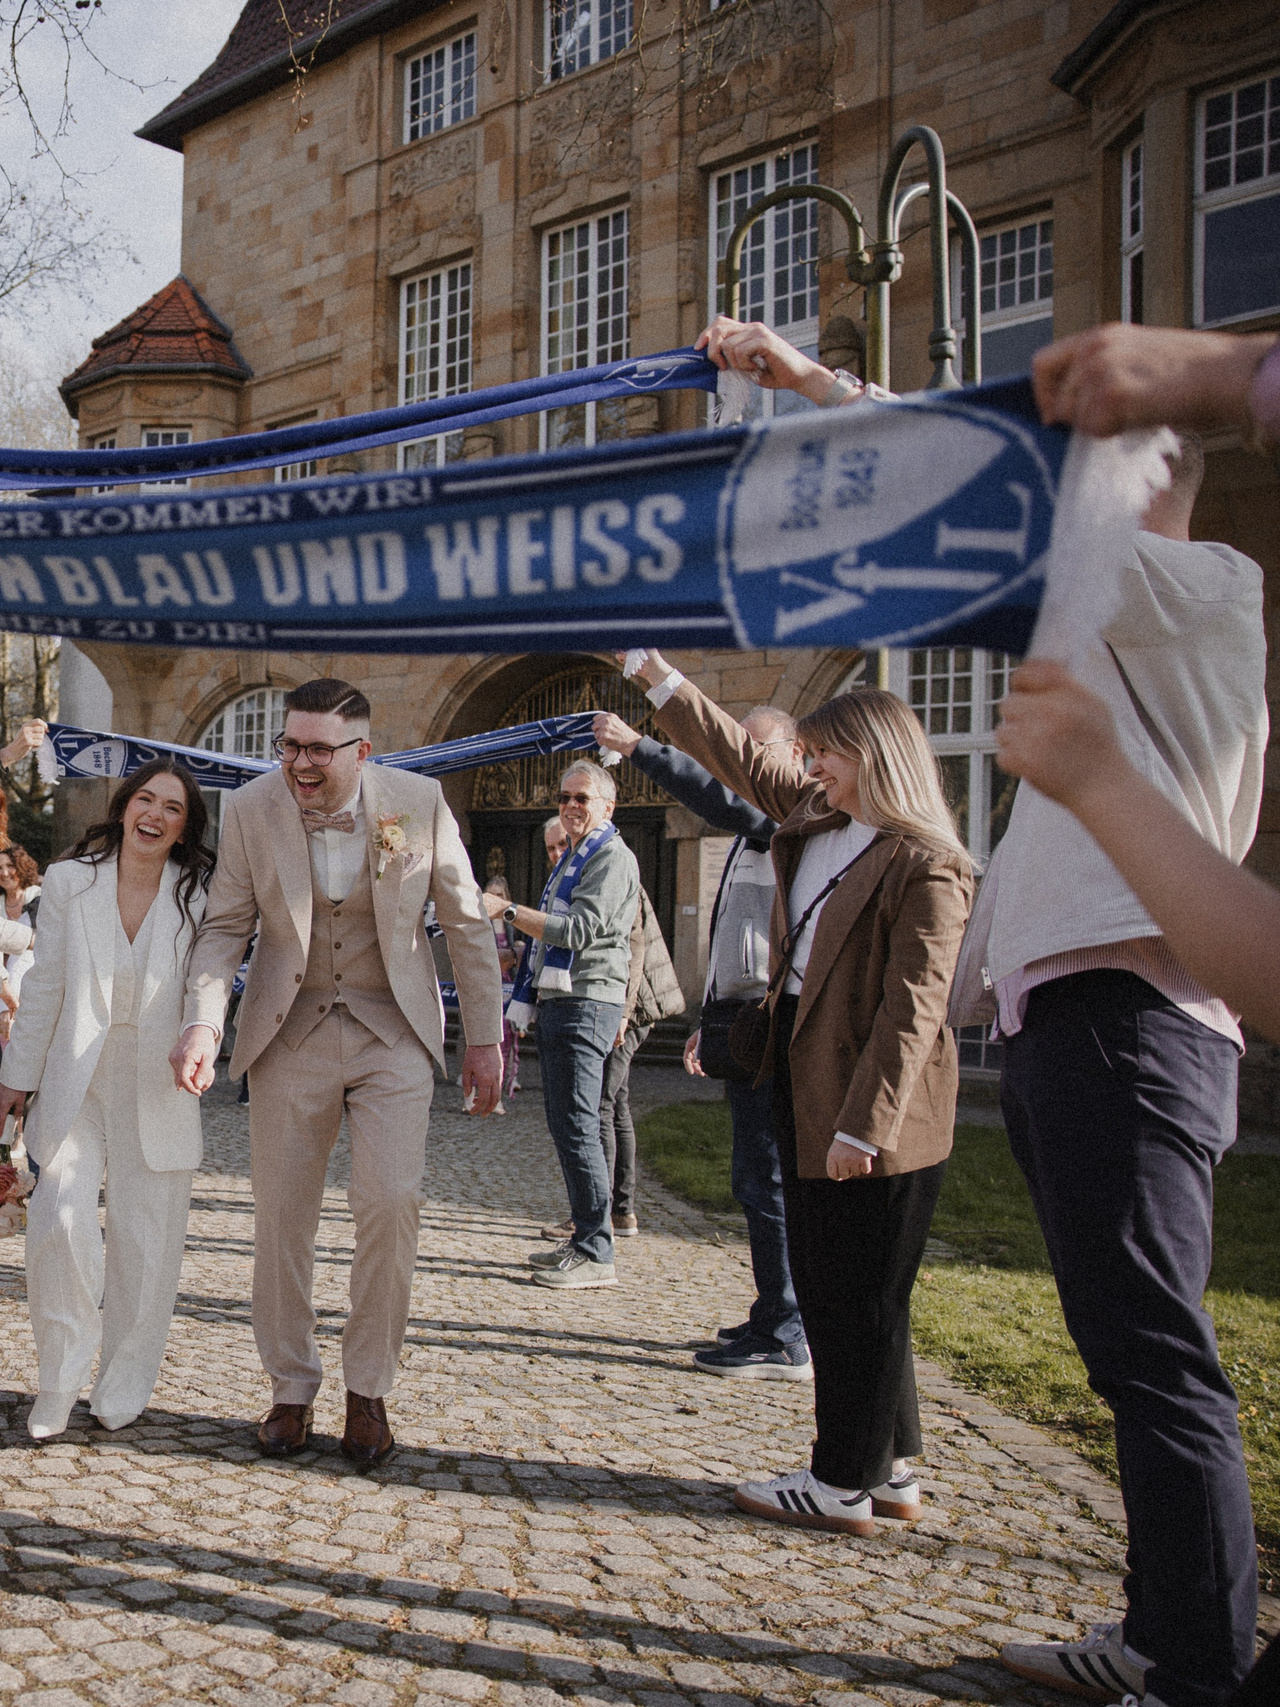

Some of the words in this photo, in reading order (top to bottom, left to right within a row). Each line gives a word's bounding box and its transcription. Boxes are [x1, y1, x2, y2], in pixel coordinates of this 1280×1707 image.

[59, 494, 291, 536] KOMMEN
[305, 476, 432, 516] WIR!
[44, 550, 235, 607] BLAU
[252, 530, 408, 607] UND
[424, 492, 686, 600] WEISS
[774, 482, 1031, 641] VfL
[94, 619, 155, 641] ZU
[173, 620, 267, 643] DIR!
[92, 749, 100, 769] 1848
[102, 746, 111, 775] Bochum
